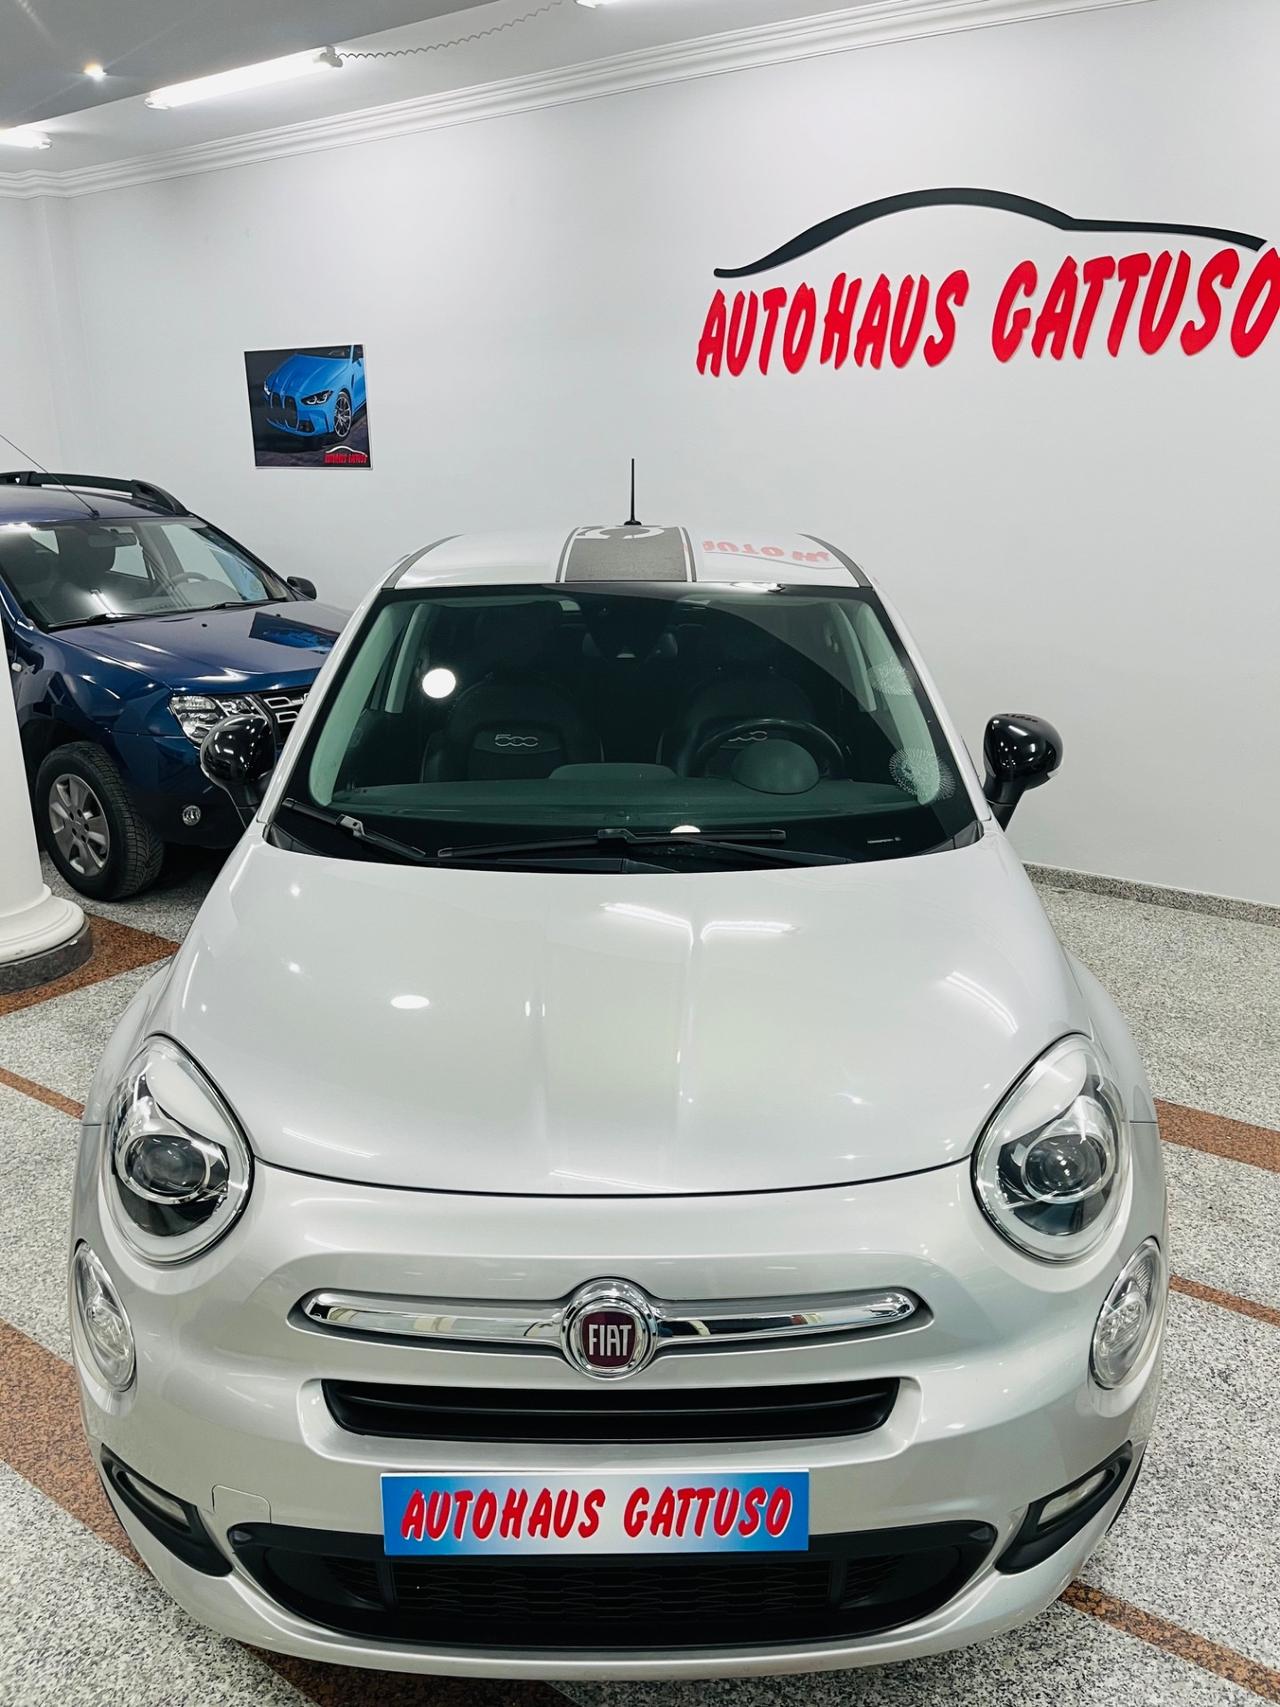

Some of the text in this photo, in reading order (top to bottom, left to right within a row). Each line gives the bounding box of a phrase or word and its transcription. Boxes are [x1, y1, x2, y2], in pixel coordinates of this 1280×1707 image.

[697, 247, 1280, 378] AUTOHAUS GATTUSO
[495, 733, 539, 747] 500
[588, 1324, 632, 1356] FIAT
[401, 1486, 793, 1540] AUTOHAUS GATTUSO
